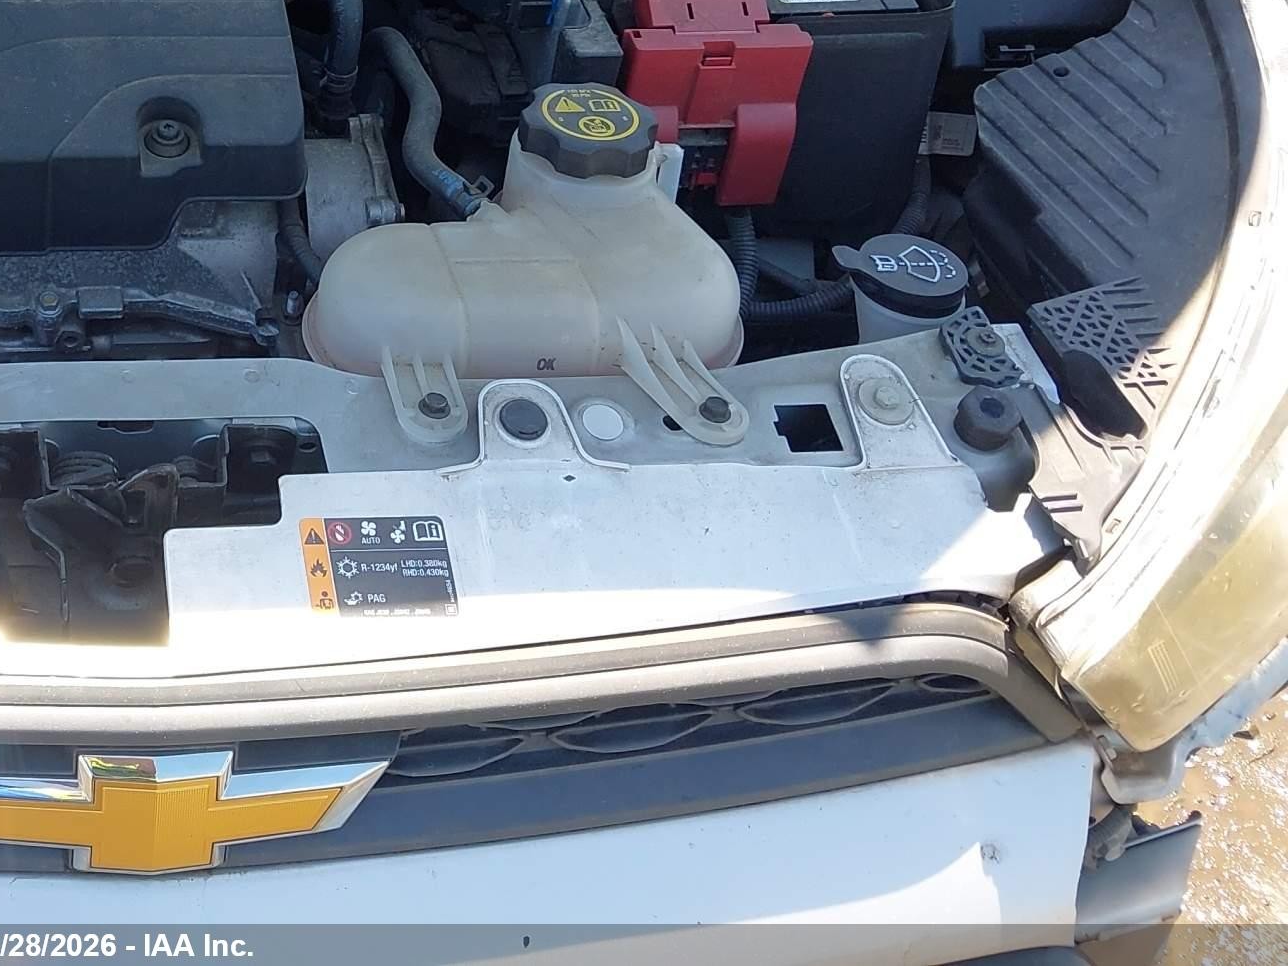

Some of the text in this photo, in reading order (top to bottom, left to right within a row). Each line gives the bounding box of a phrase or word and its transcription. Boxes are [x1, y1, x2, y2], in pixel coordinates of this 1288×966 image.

[536, 358, 557, 371] OK
[360, 563, 398, 573] R-1234yf
[367, 594, 386, 603] PAG
